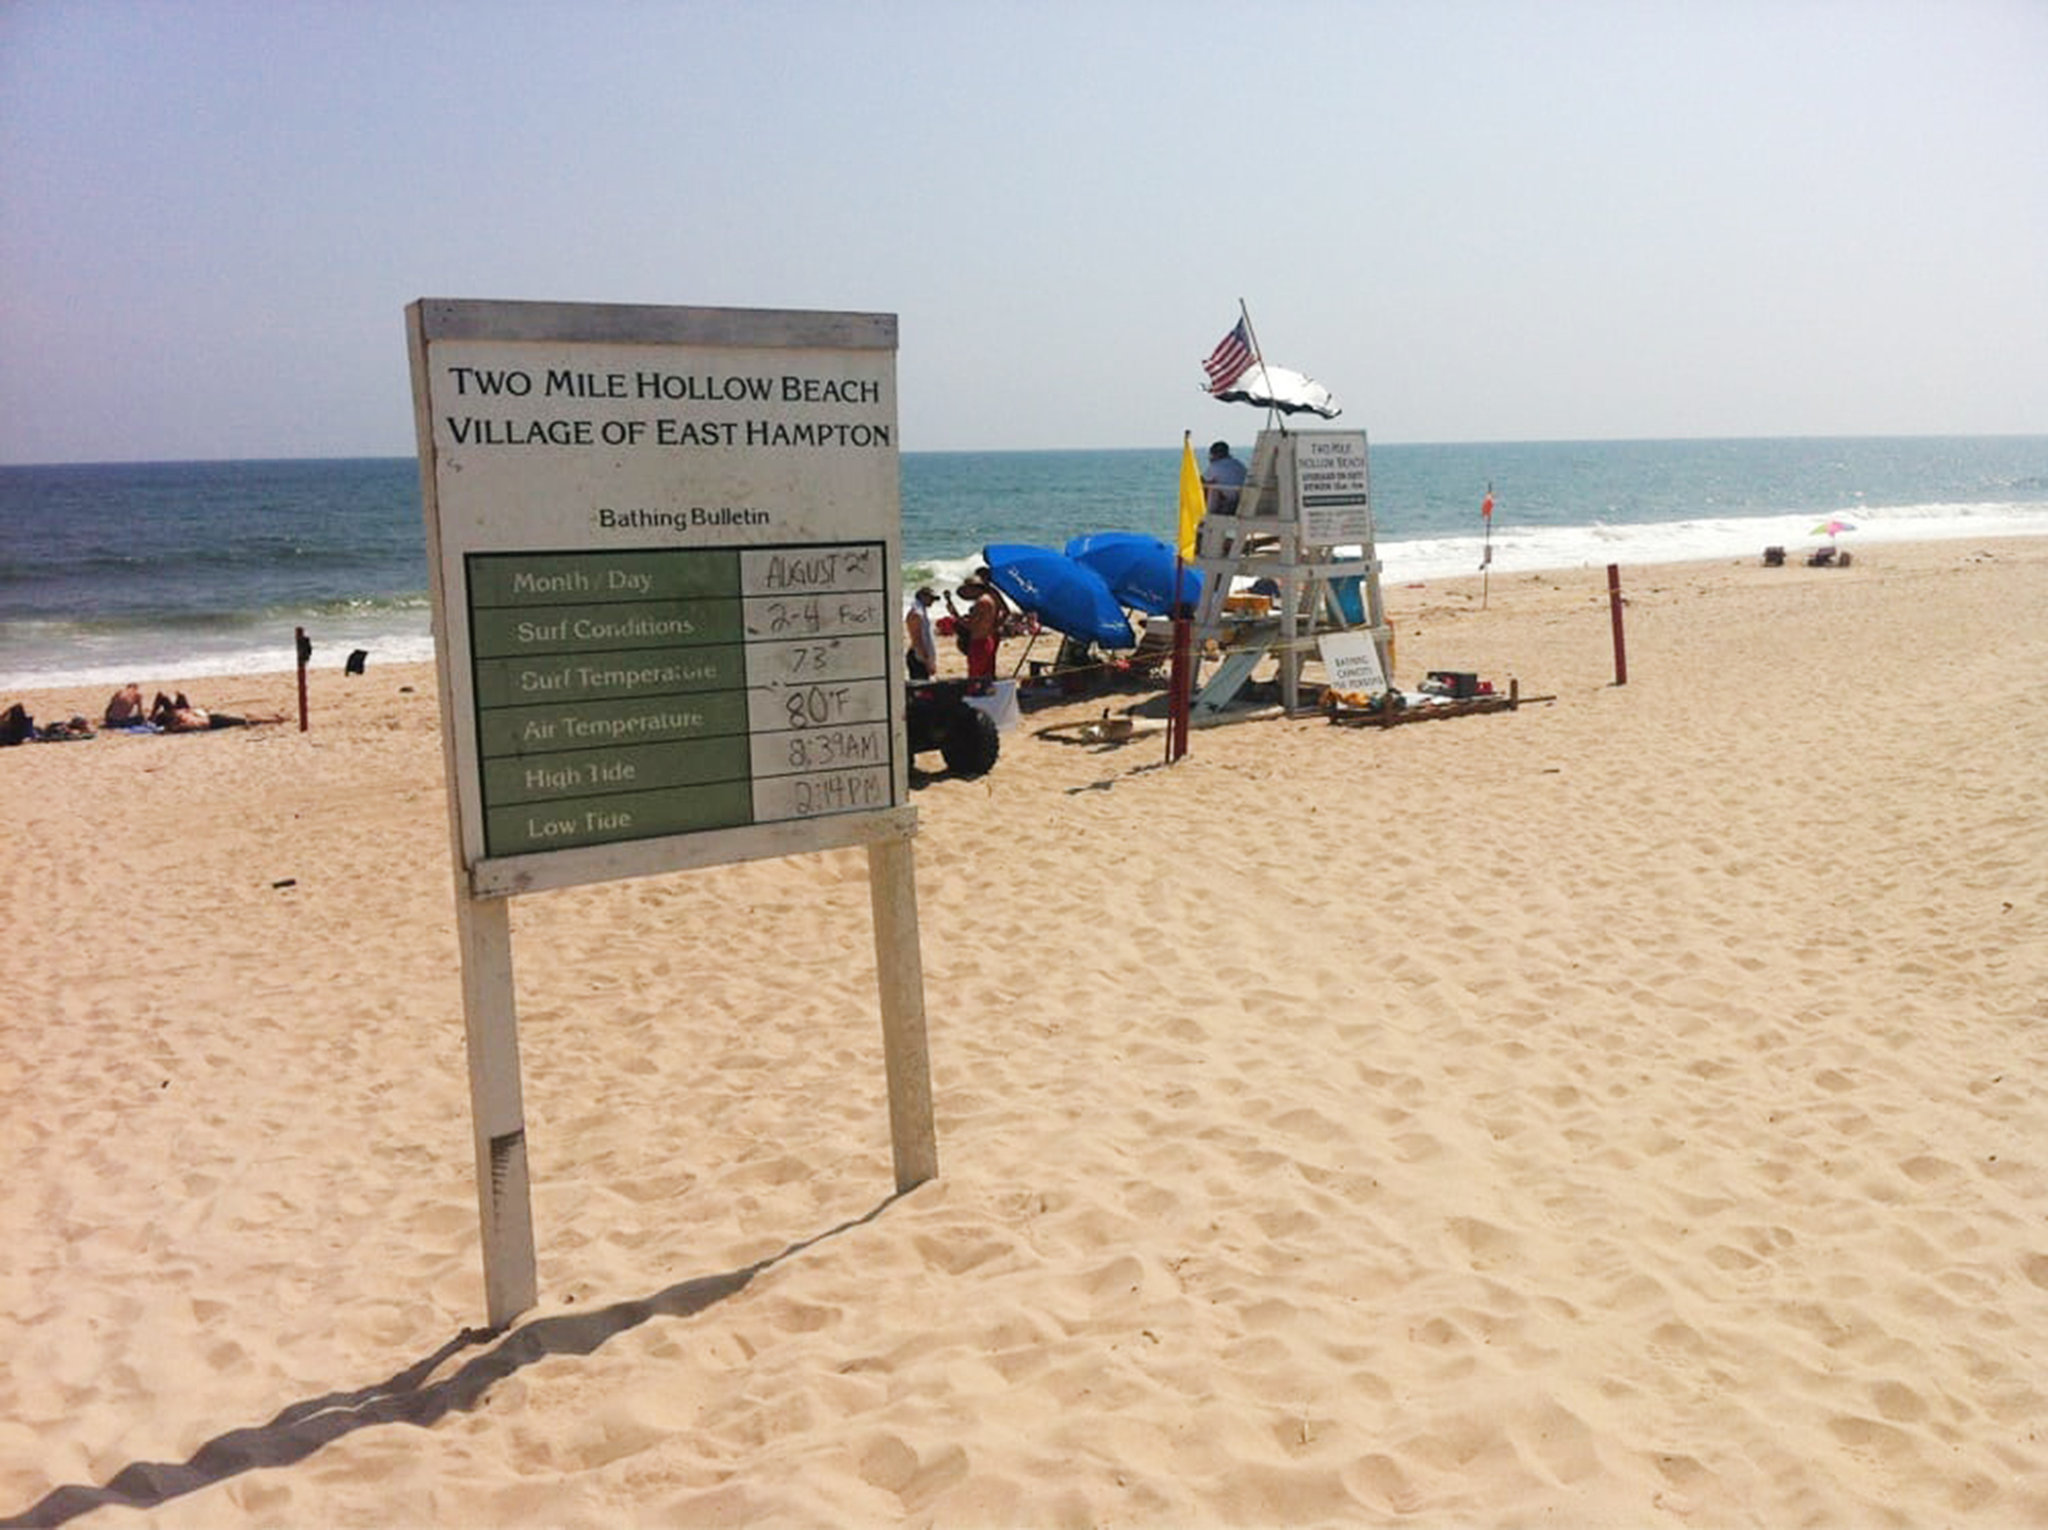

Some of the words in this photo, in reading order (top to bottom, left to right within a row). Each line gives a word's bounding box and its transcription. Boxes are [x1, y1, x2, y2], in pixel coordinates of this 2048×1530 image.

[449, 367, 532, 398] TWO
[545, 370, 628, 399] MILE
[637, 372, 774, 401] HOLLOW
[781, 376, 880, 403] BEACH
[447, 417, 595, 445] VILLAGE
[602, 421, 646, 445] OF
[657, 419, 738, 446] EAST
[747, 421, 890, 448] HAMPTON
[599, 508, 688, 532] Bathing
[690, 507, 771, 527] Bulletin
[513, 571, 589, 594] Month
[608, 570, 652, 593] Day
[517, 619, 568, 642] Surf
[573, 616, 696, 640] Conditions
[767, 599, 821, 633] 2-4
[520, 668, 571, 692] Surf
[523, 720, 555, 741] Air
[563, 712, 704, 738] Temperature
[525, 767, 582, 790] High
[588, 760, 637, 783] Tide
[528, 817, 577, 838] Low
[585, 811, 633, 832] Tide
